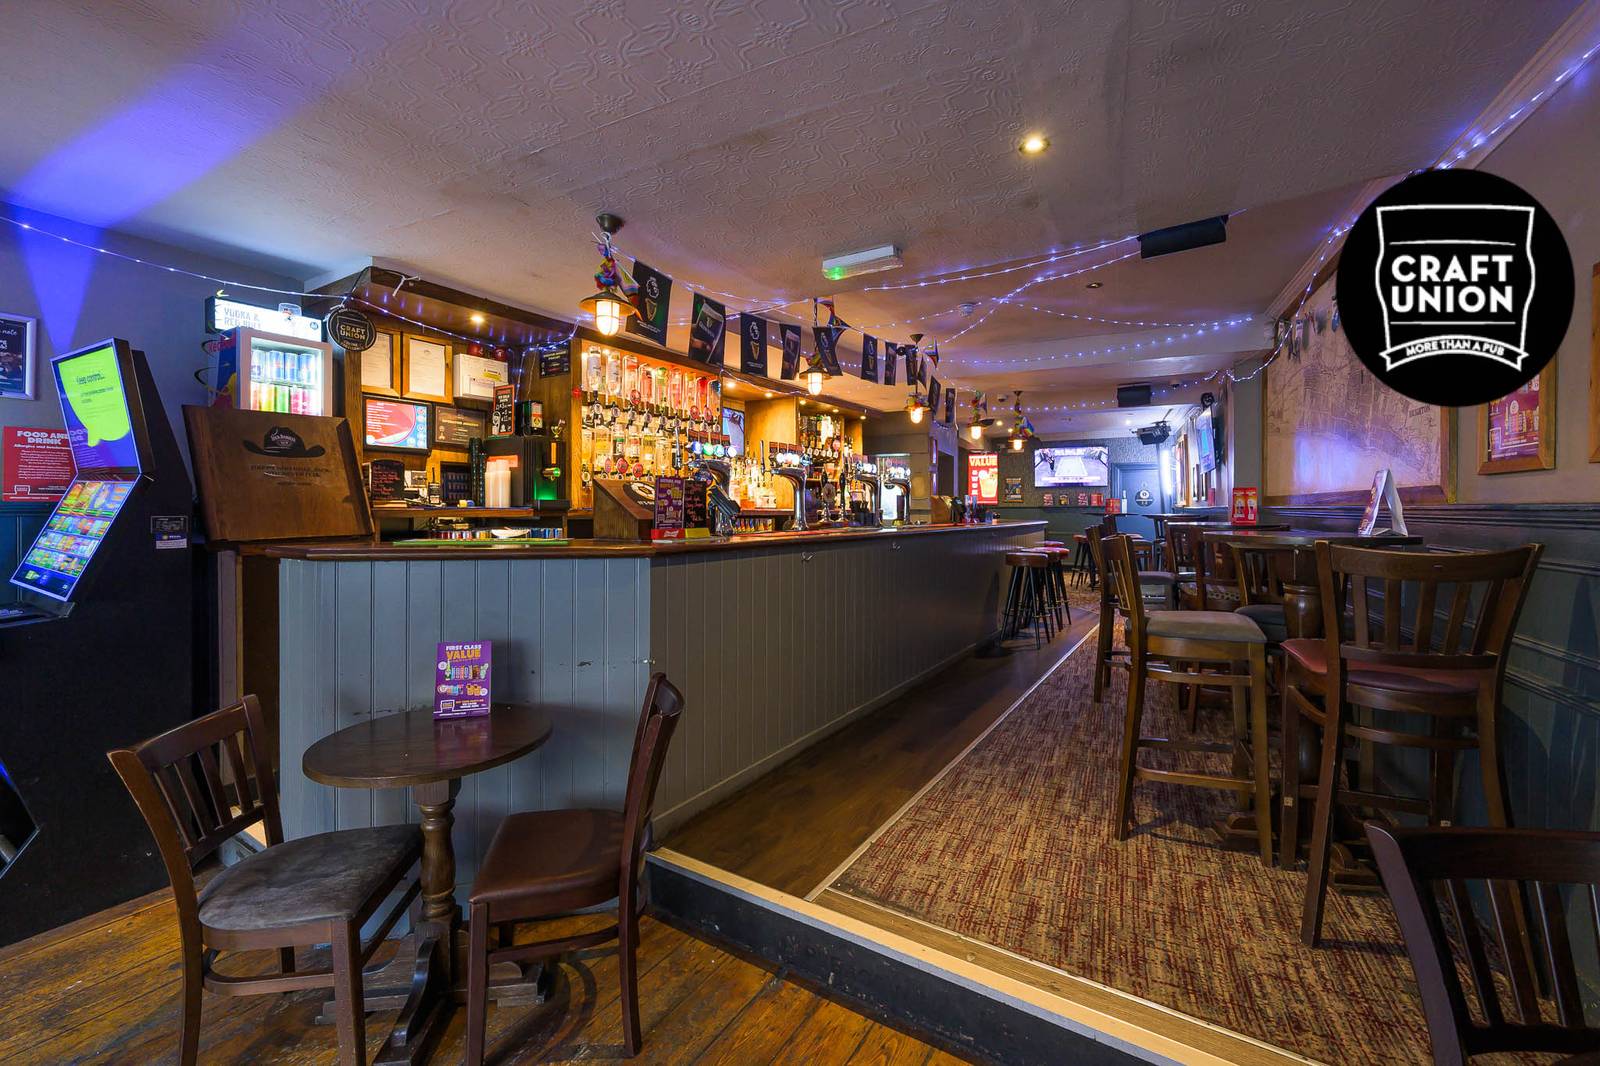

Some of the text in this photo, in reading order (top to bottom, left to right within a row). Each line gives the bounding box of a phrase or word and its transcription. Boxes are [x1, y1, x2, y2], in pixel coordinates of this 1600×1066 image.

[340, 325, 365, 335] CRAFT
[340, 329, 365, 340] UNION
[16, 430, 48, 438] FOOD
[27, 437, 61, 445] DRINK
[969, 456, 997, 467] VALUE
[446, 649, 481, 660] VALUE
